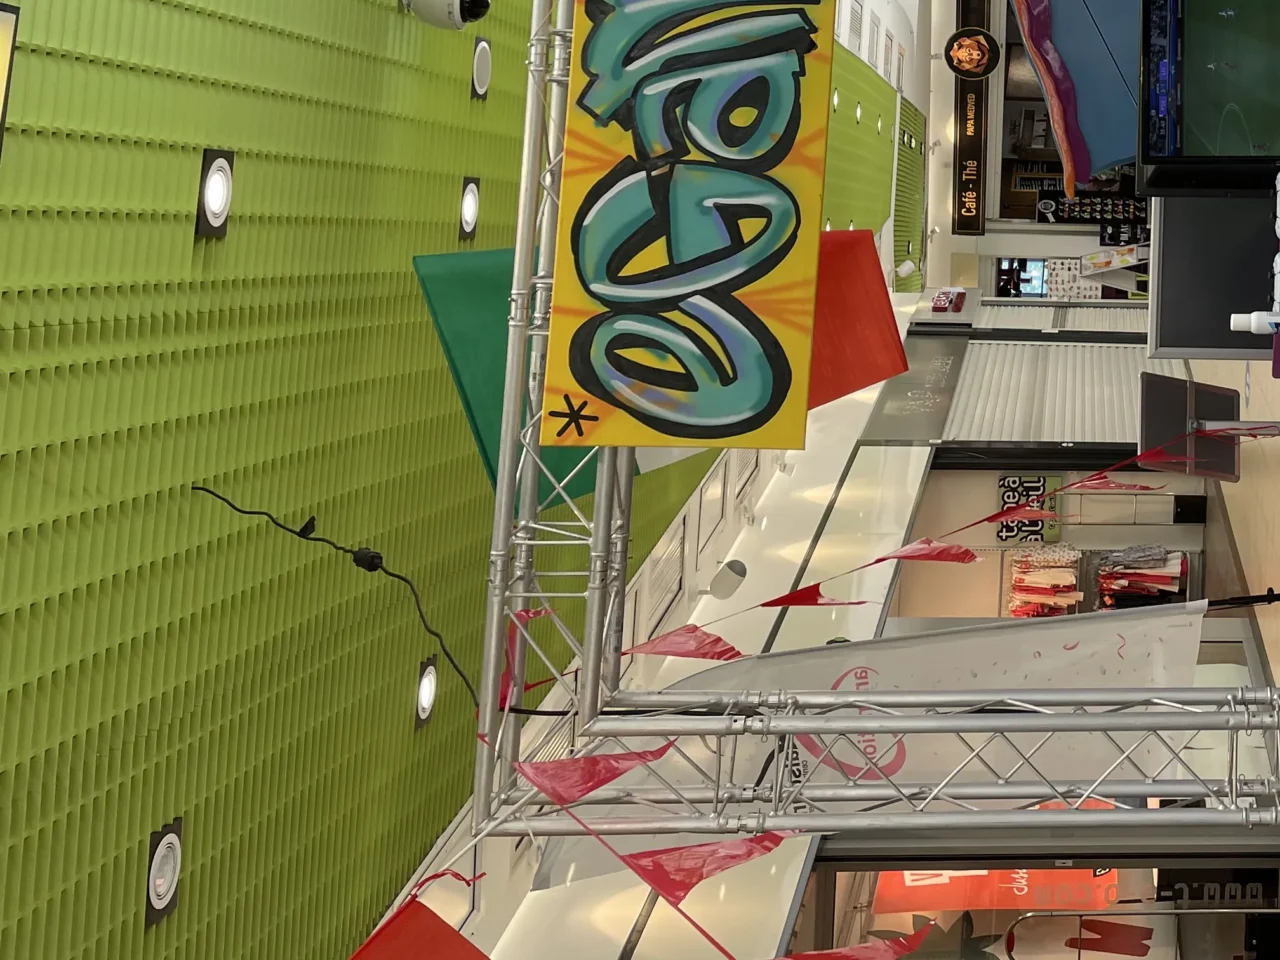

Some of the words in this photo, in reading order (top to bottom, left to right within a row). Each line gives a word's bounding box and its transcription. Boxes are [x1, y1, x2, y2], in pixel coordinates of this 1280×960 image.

[967, 93, 976, 119] MEDVED
[966, 119, 975, 136] PAPA
[962, 160, 978, 181] Thé
[961, 191, 976, 216] Café
